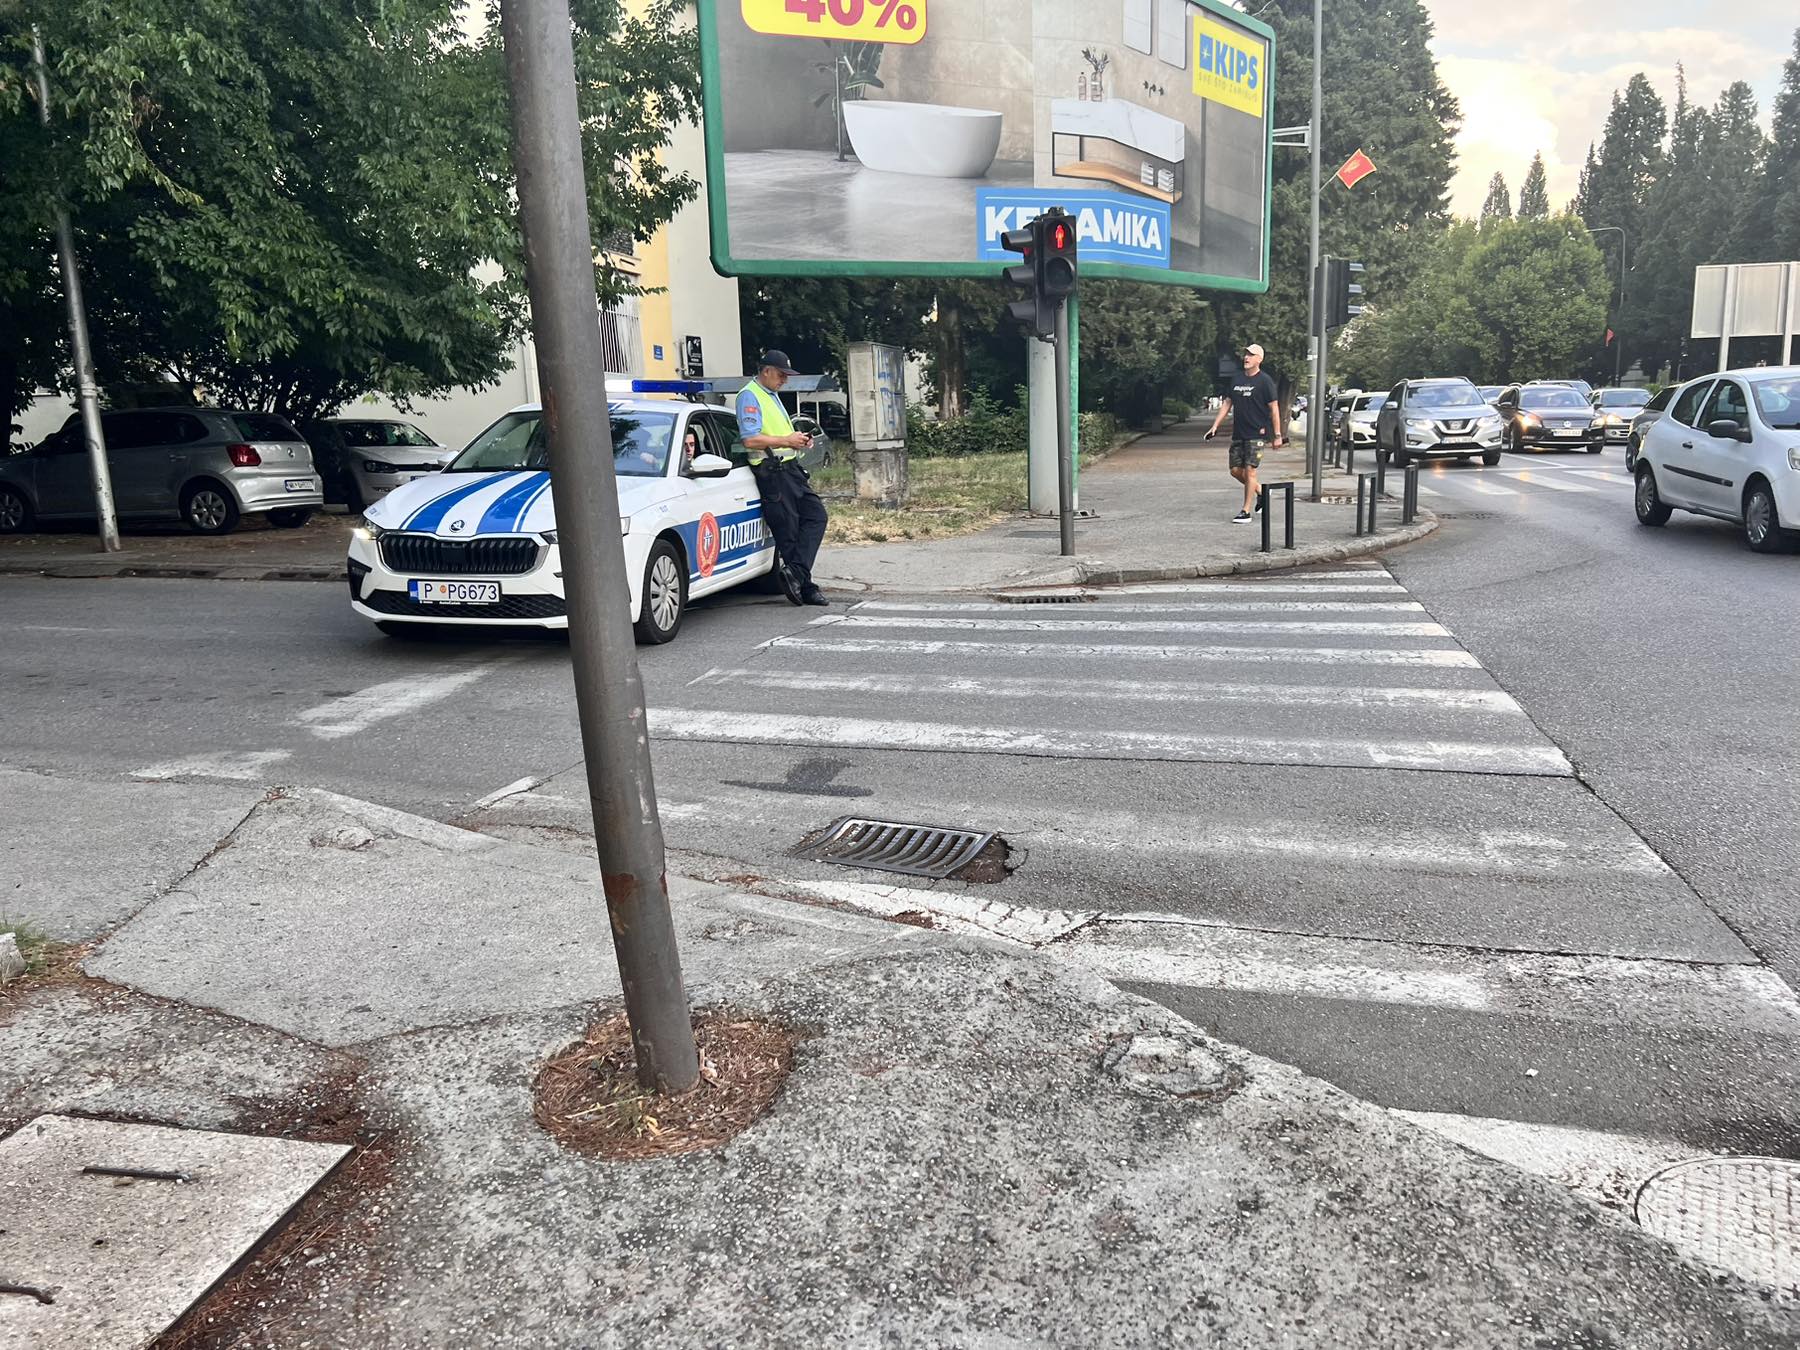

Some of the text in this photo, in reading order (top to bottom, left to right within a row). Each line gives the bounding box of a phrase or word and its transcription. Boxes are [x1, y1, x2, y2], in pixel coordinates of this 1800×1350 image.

[1215, 40, 1258, 89] KIPS
[985, 206, 1162, 250] KEAMIKA
[424, 583, 497, 600] P PG673
